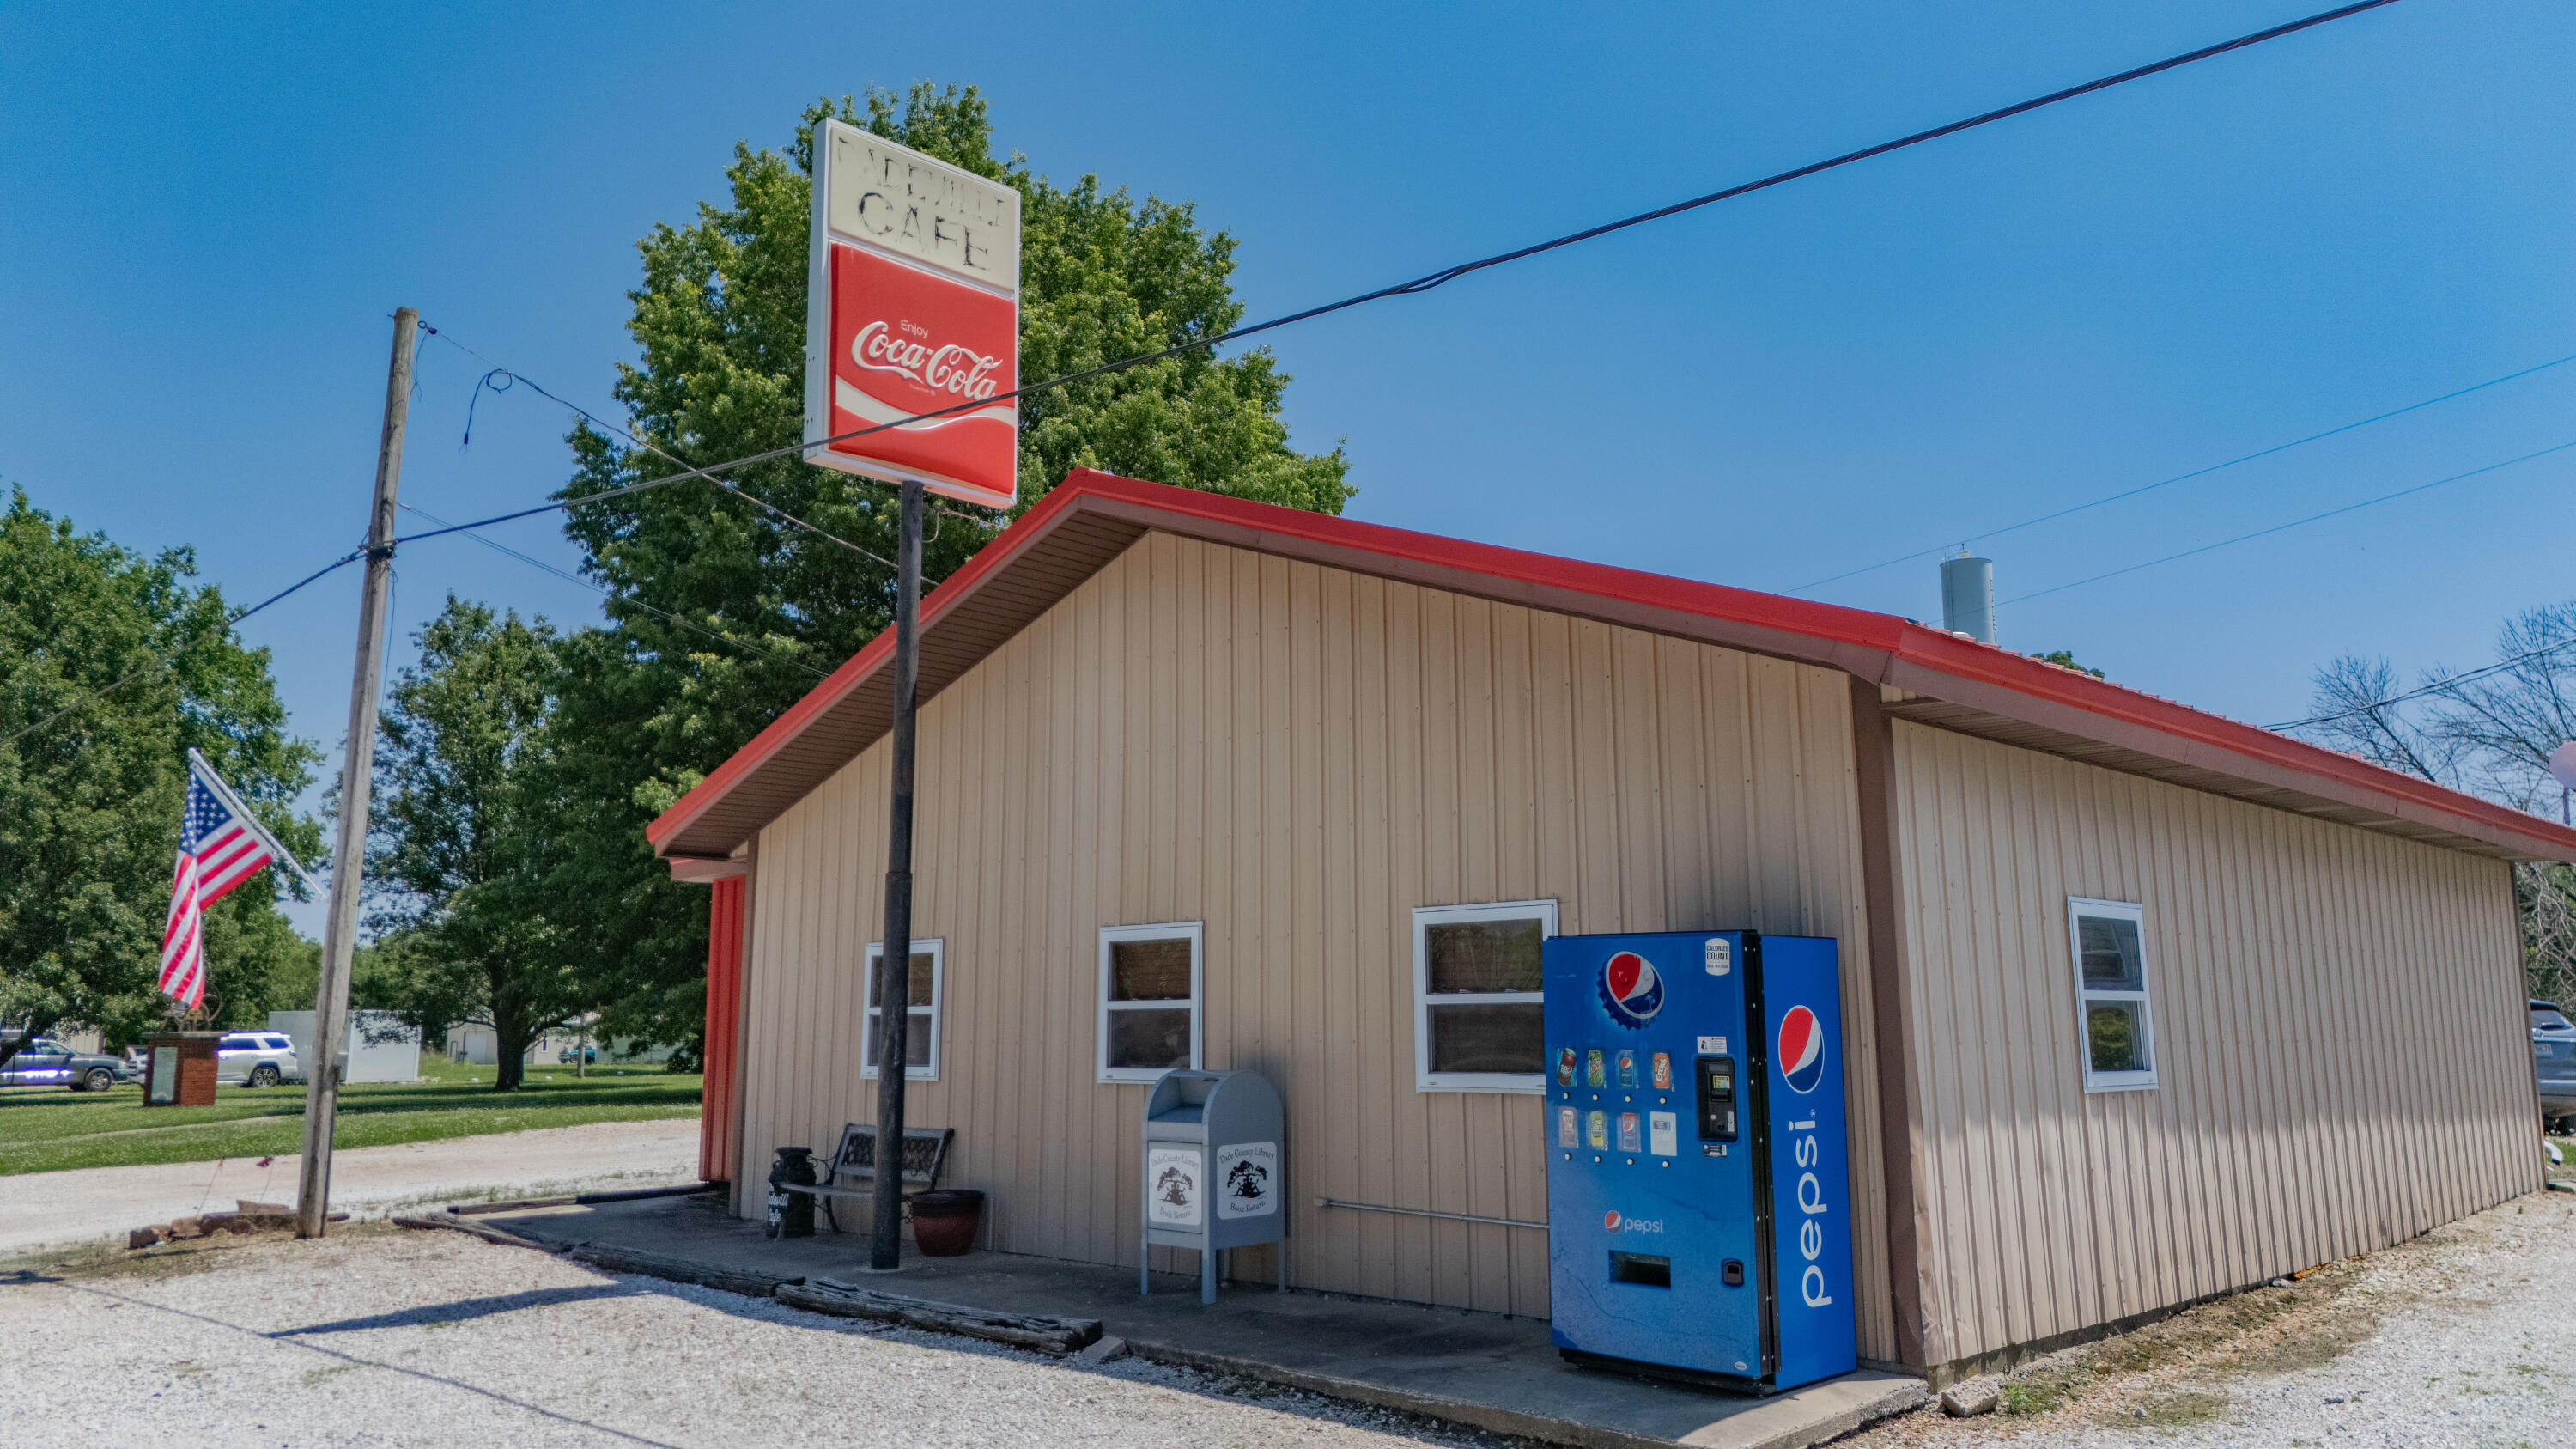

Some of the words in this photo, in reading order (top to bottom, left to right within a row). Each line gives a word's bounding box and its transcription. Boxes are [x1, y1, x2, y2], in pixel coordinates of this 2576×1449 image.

[859, 192, 991, 271] CAFE
[900, 319, 929, 339] Enjoy
[851, 320, 1004, 401] Coca-Cola
[1706, 952, 1729, 960] COUNT
[1624, 1218, 1663, 1234] pepsi
[1788, 1120, 1832, 1308] pepsi
